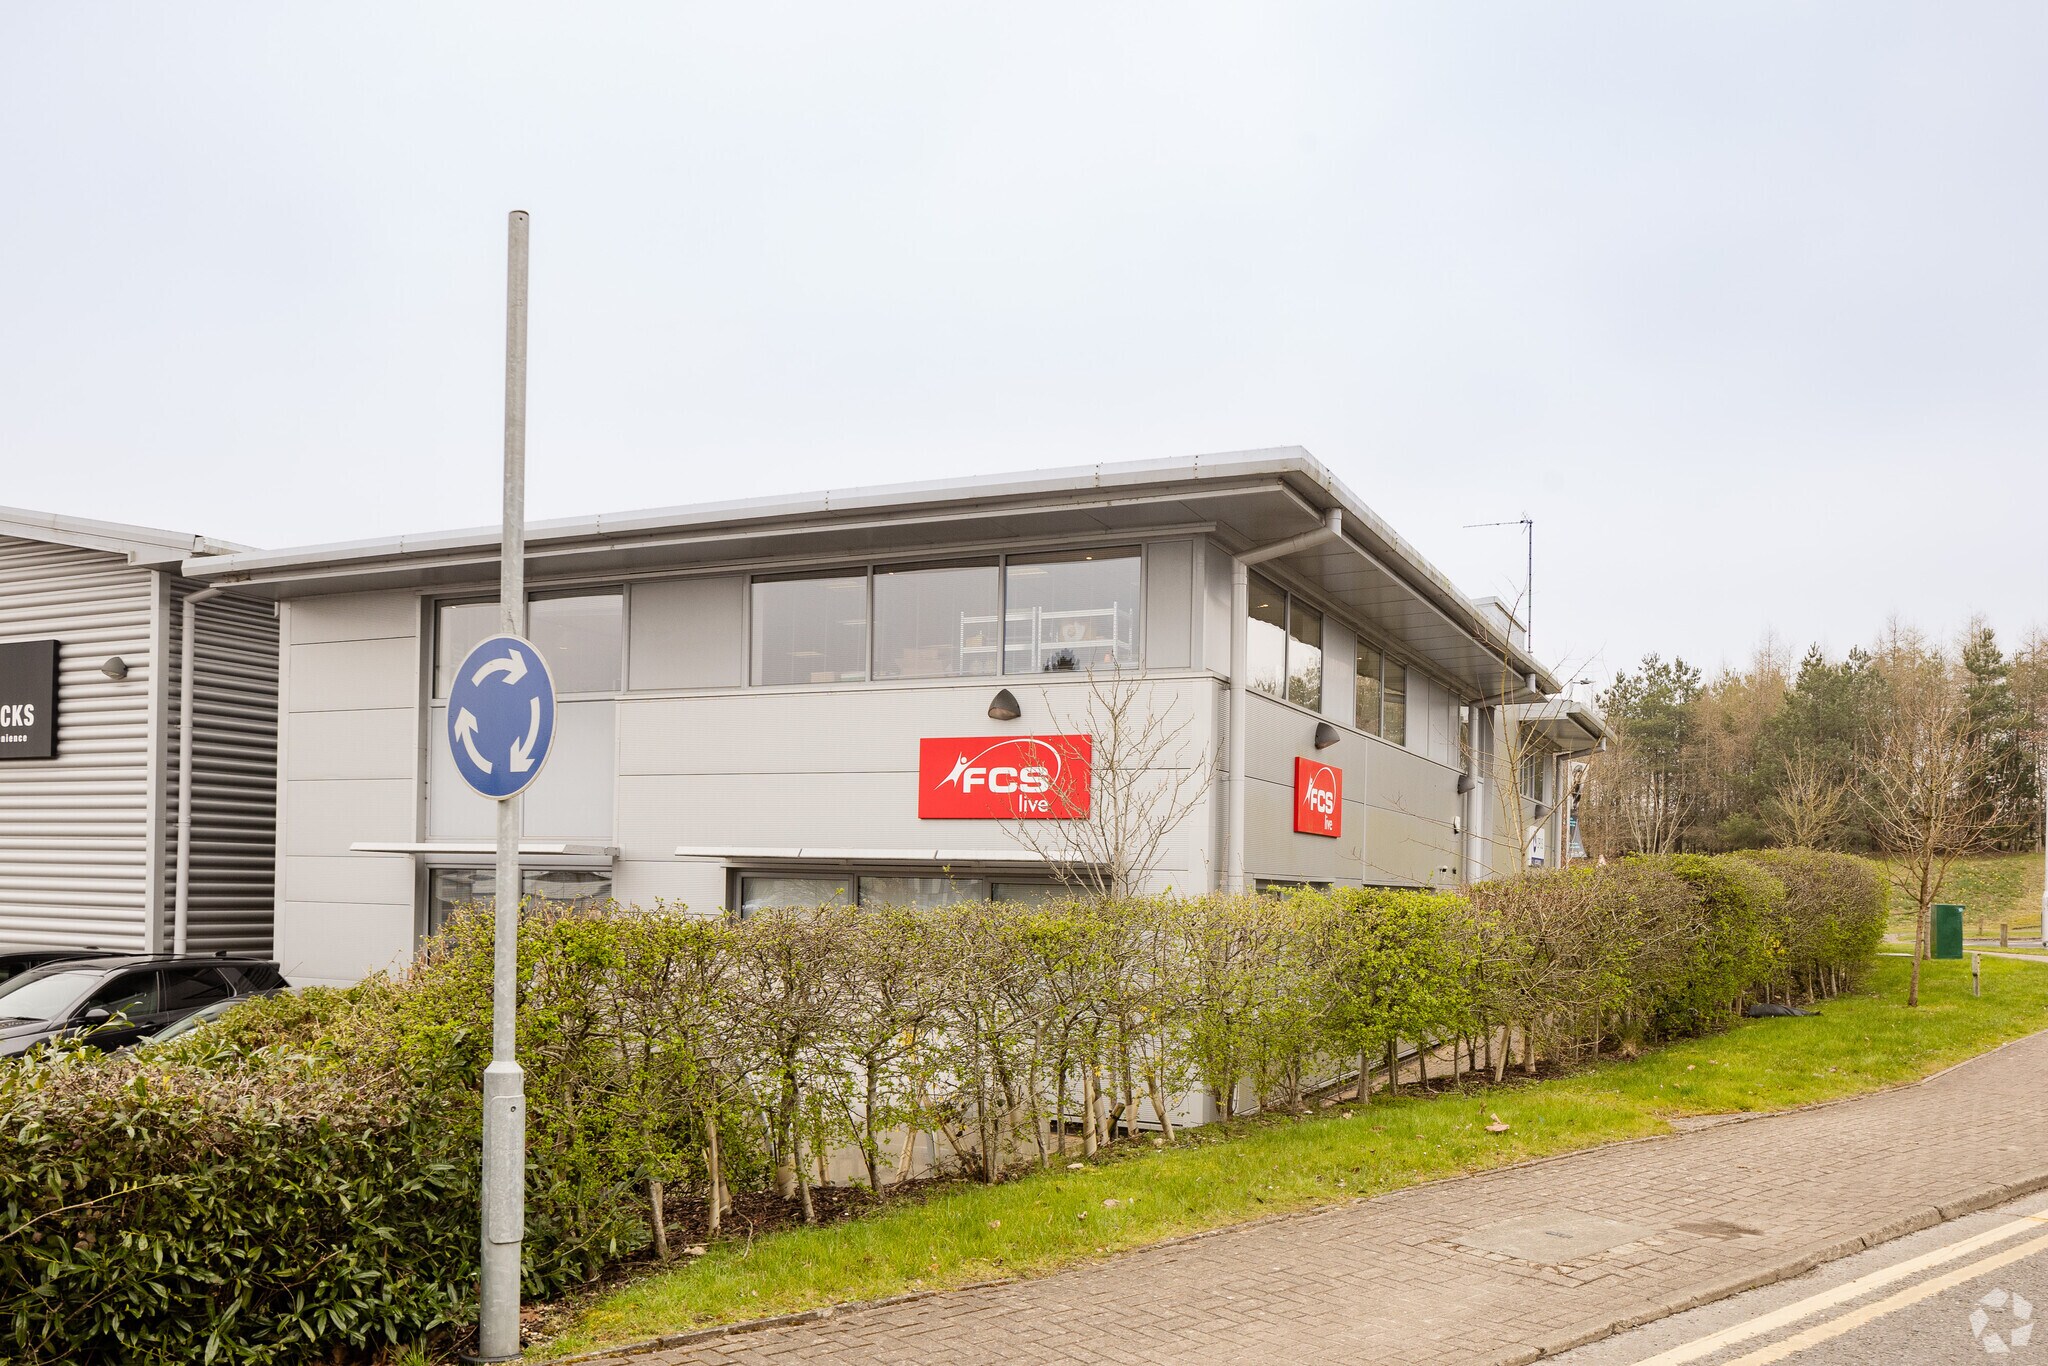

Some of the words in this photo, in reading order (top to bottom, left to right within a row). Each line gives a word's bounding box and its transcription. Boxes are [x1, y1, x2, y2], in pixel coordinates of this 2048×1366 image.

[0, 703, 35, 727] CKS
[962, 767, 1049, 793] FCS
[1019, 794, 1049, 813] live
[1310, 788, 1333, 814] FCS
